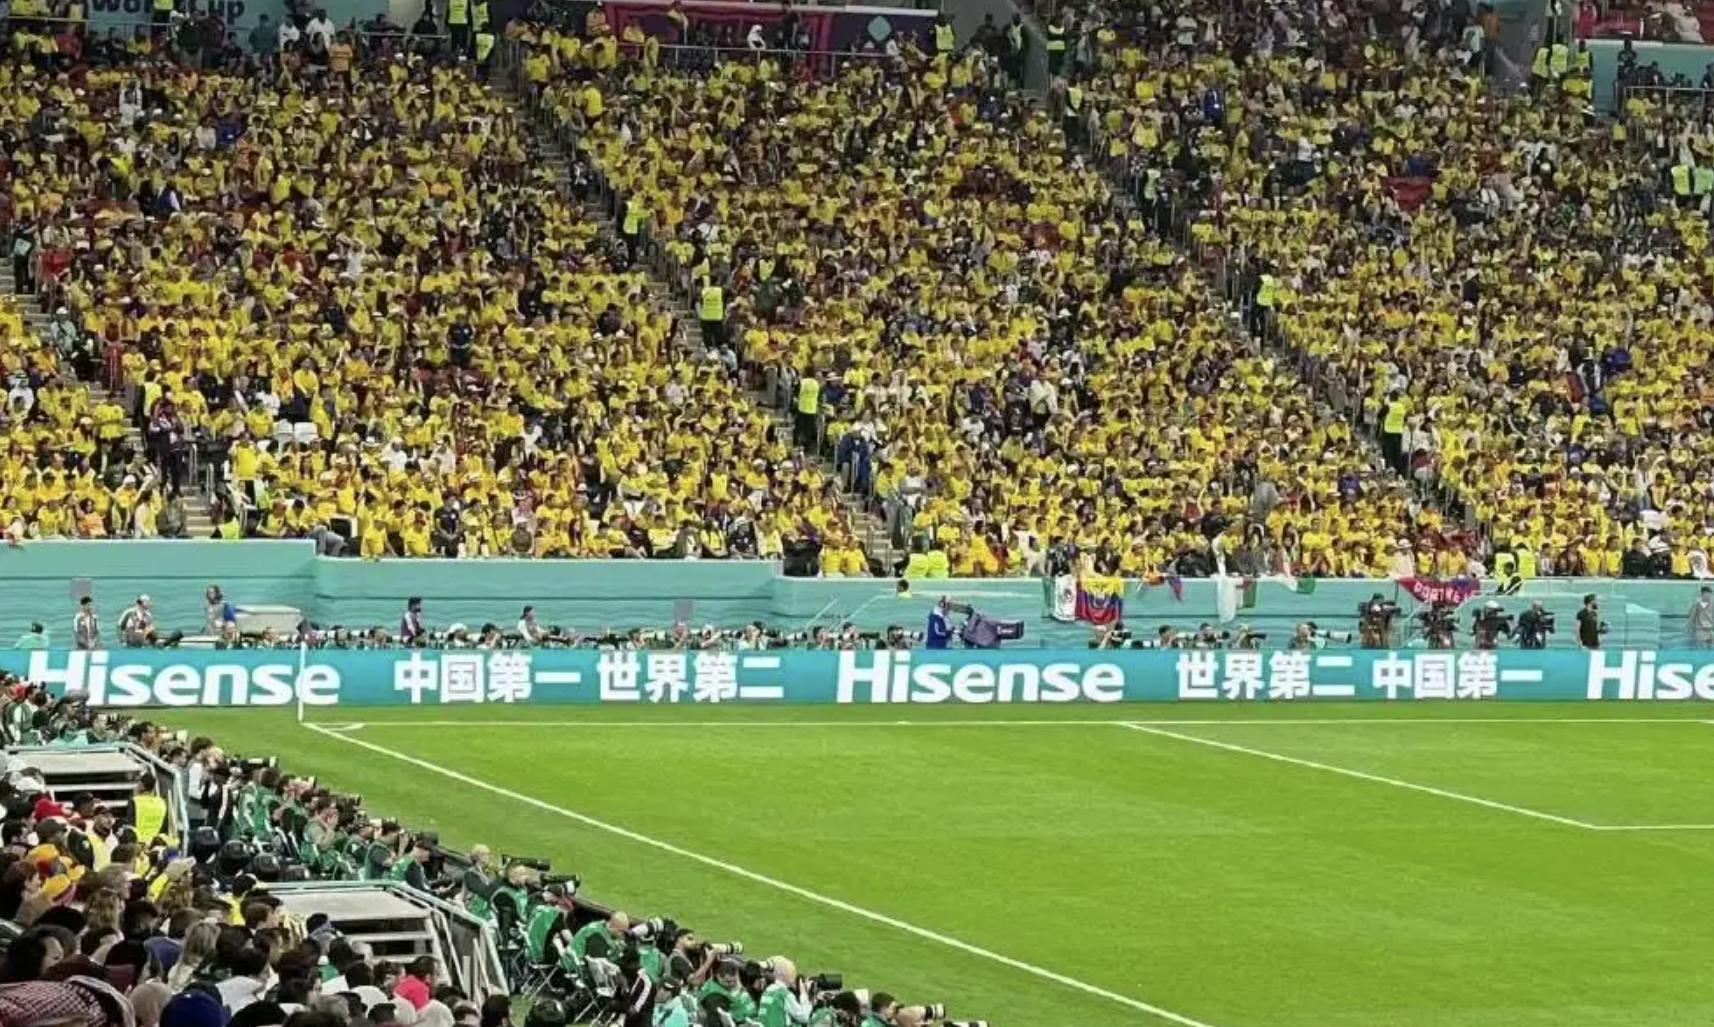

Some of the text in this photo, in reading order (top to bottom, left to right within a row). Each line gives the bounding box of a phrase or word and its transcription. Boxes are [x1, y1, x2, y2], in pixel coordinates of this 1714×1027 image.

[28, 650, 341, 704] Hisense
[393, 651, 784, 703] 中国第一 世界第二
[836, 651, 1125, 703] Hisense
[1176, 651, 1543, 699] 世界第二 中国第一
